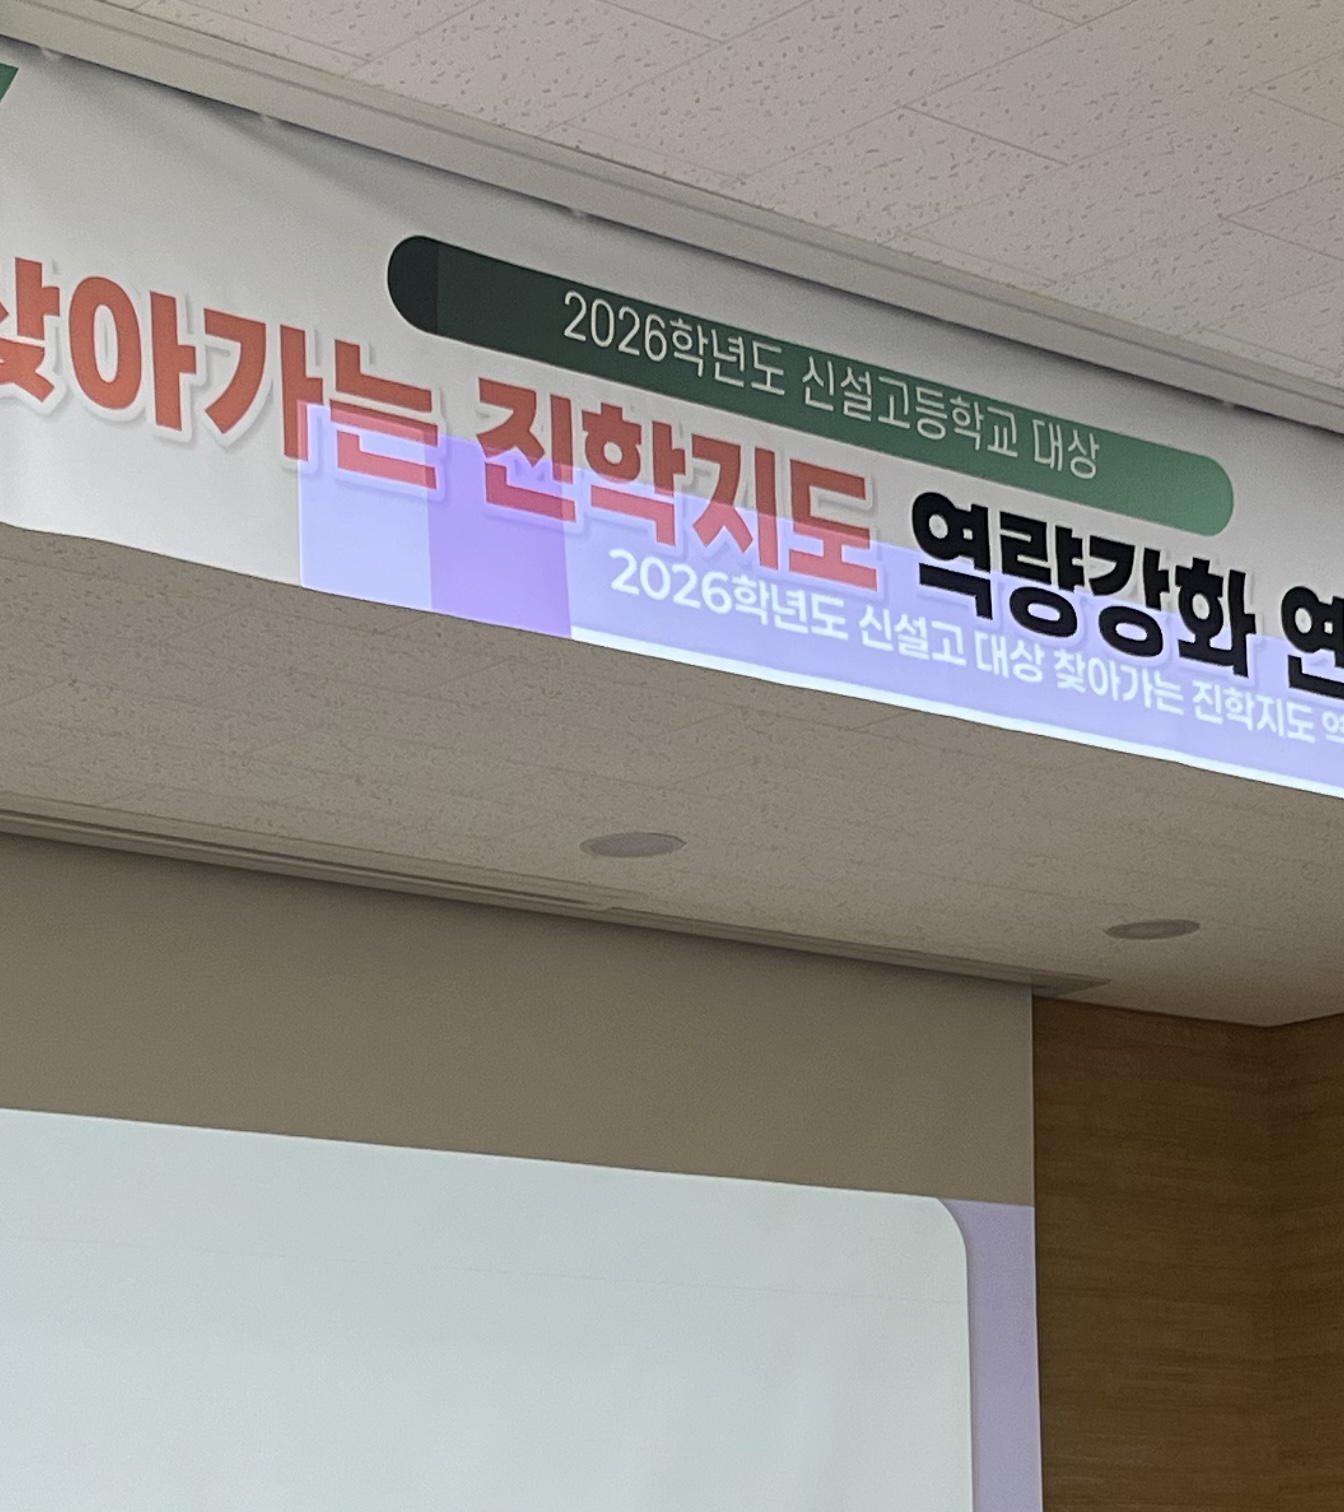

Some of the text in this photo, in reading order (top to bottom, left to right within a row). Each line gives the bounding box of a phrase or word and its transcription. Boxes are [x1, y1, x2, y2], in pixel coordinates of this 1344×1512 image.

[562, 290, 1100, 480] 2026학년도 신설고등학교 대상
[477, 377, 878, 592] 진학지도
[912, 491, 1258, 679] 역량강화
[608, 548, 849, 641] 2026학년도
[859, 605, 966, 669] 신설고
[975, 628, 1045, 684] 대상
[1054, 650, 1183, 714] 찾아가는
[1192, 680, 1316, 744] 진학지도
